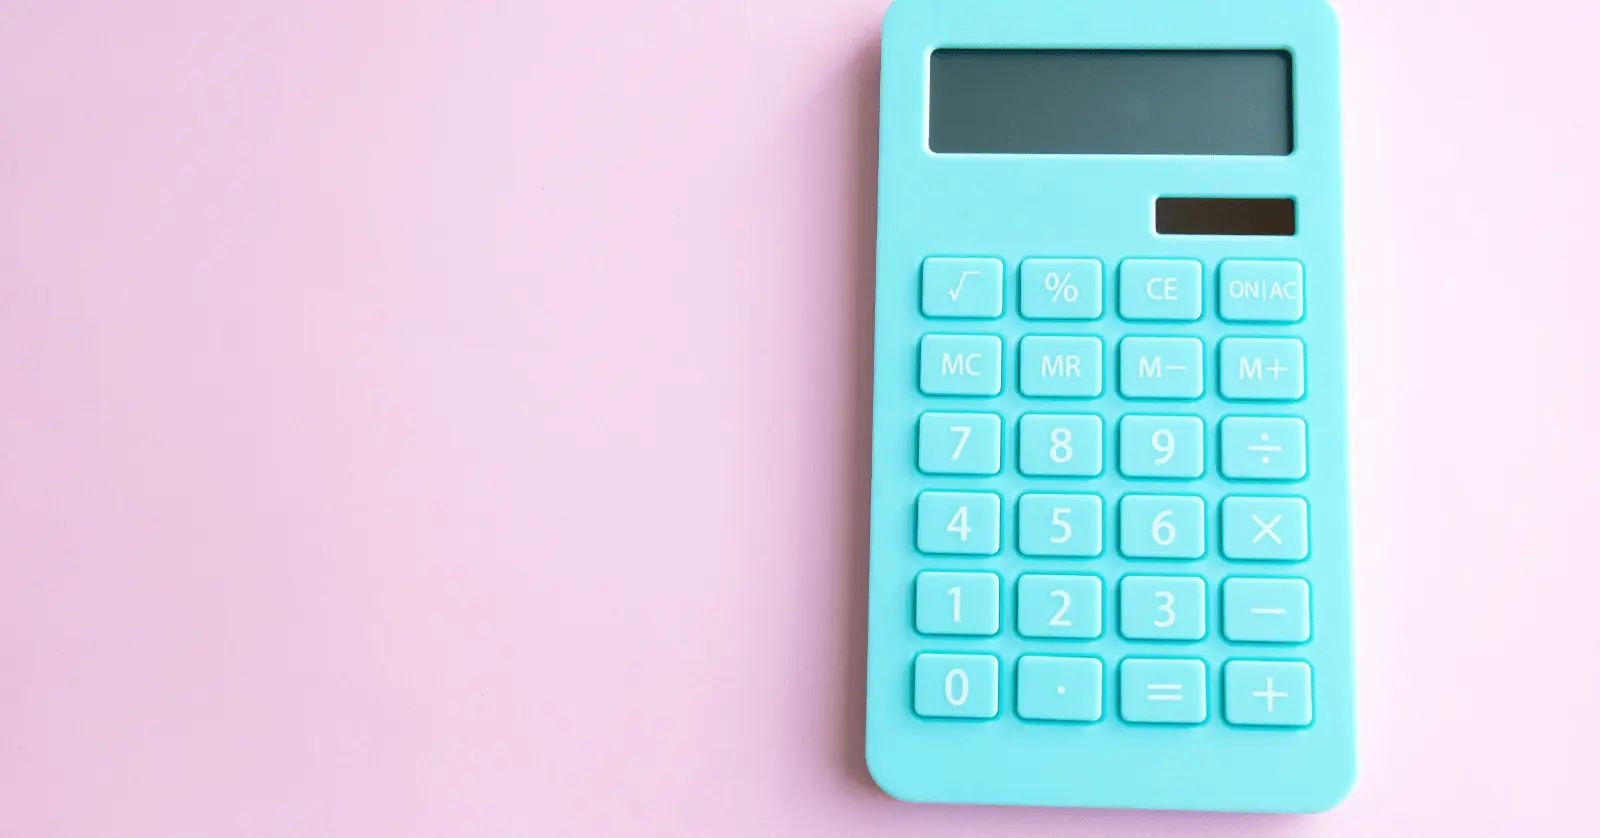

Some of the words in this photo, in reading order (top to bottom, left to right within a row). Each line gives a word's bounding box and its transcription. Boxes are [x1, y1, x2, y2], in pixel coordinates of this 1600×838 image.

[1044, 271, 1079, 303] %
[1146, 277, 1178, 301] CE
[941, 352, 982, 376] MC
[1041, 354, 1081, 378] MR
[1239, 356, 1288, 381] M+
[949, 425, 972, 461] 7
[1049, 427, 1073, 463] 8
[1151, 428, 1175, 465] 9
[1247, 432, 1283, 464] ÷
[946, 505, 972, 541] 4
[1050, 507, 1072, 544] 5
[1151, 509, 1177, 546] 6
[947, 586, 961, 623] 1
[1049, 589, 1072, 627] 2
[1153, 590, 1176, 628] 3
[945, 668, 969, 706] 0
[1146, 683, 1183, 701] =
[1252, 676, 1288, 713] +
